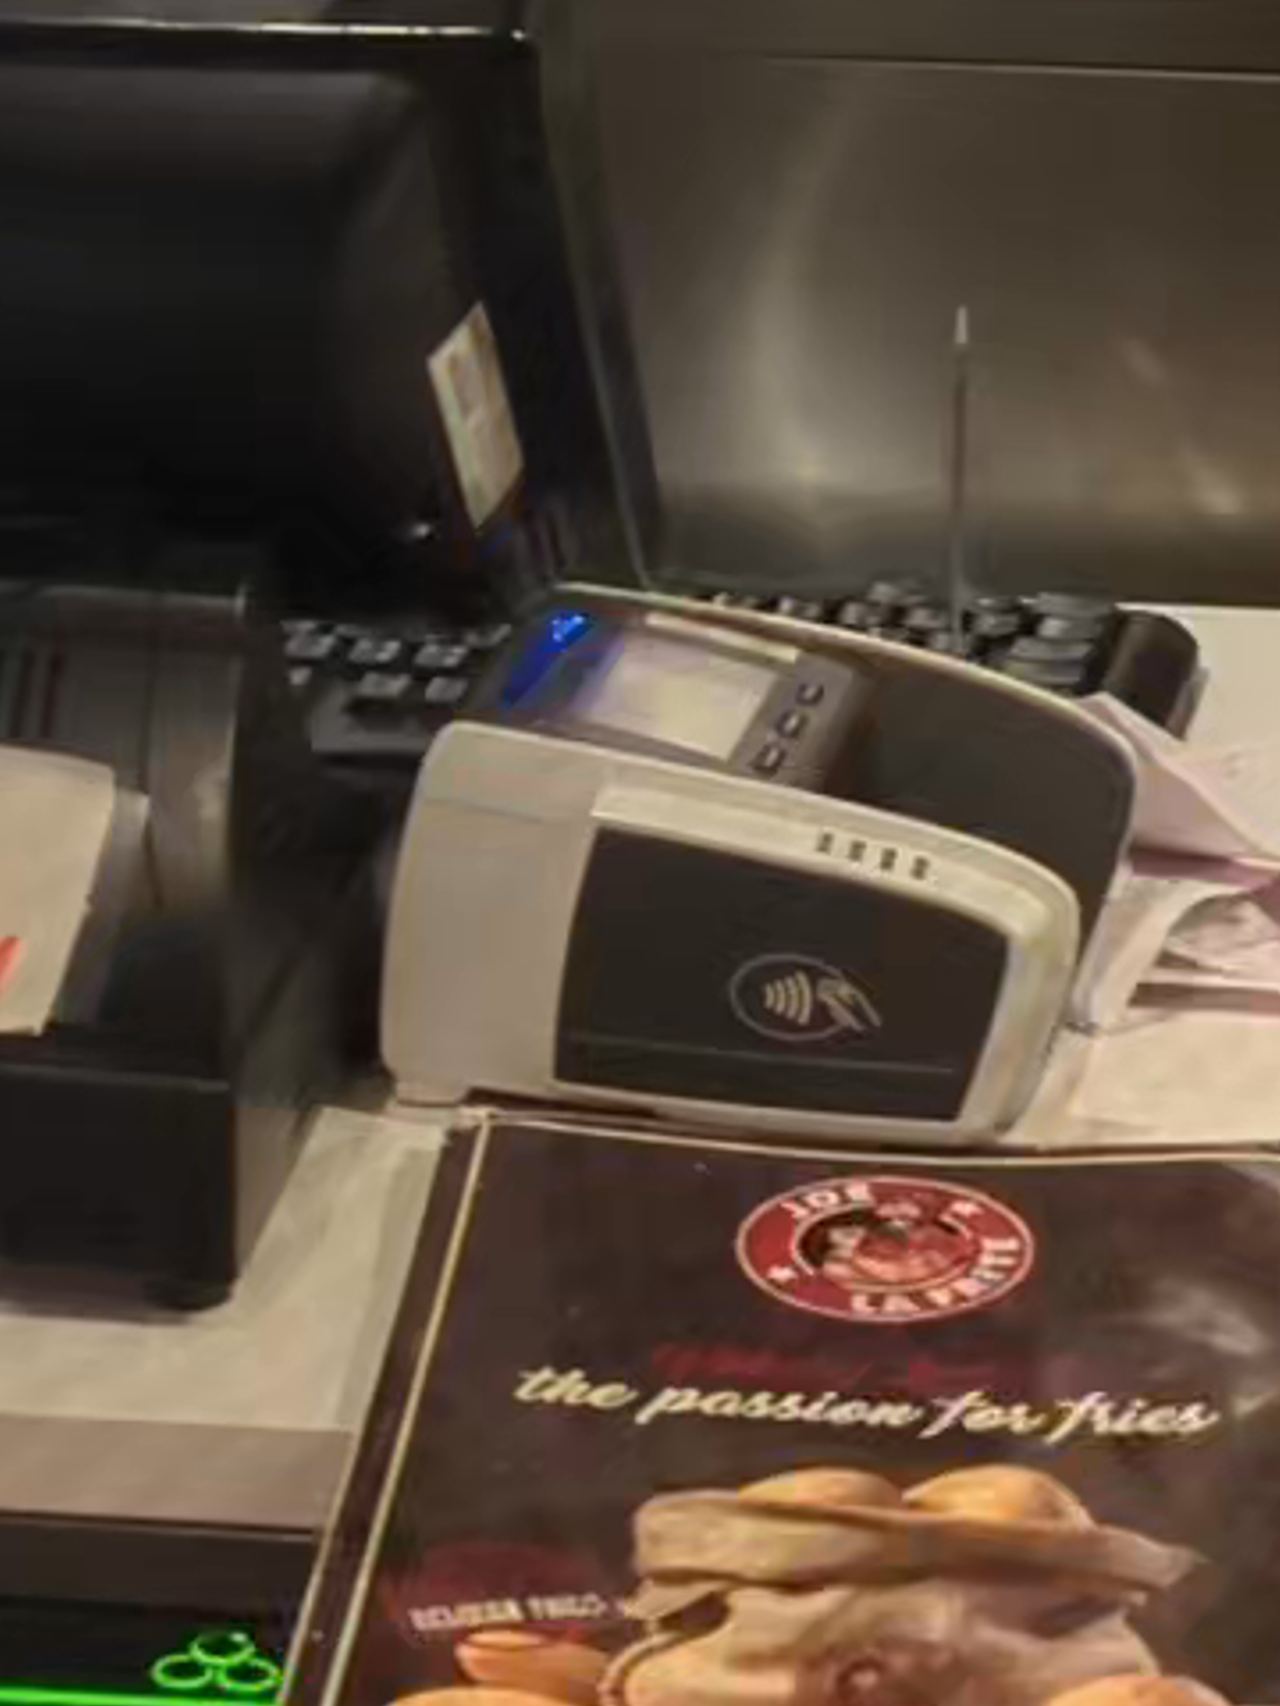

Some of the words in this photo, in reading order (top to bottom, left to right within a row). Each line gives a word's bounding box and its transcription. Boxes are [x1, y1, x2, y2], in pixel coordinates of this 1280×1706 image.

[514, 1366, 640, 1410] the
[635, 1382, 924, 1428] passion
[919, 1389, 1050, 1441] for
[1044, 1389, 1222, 1445] fries
